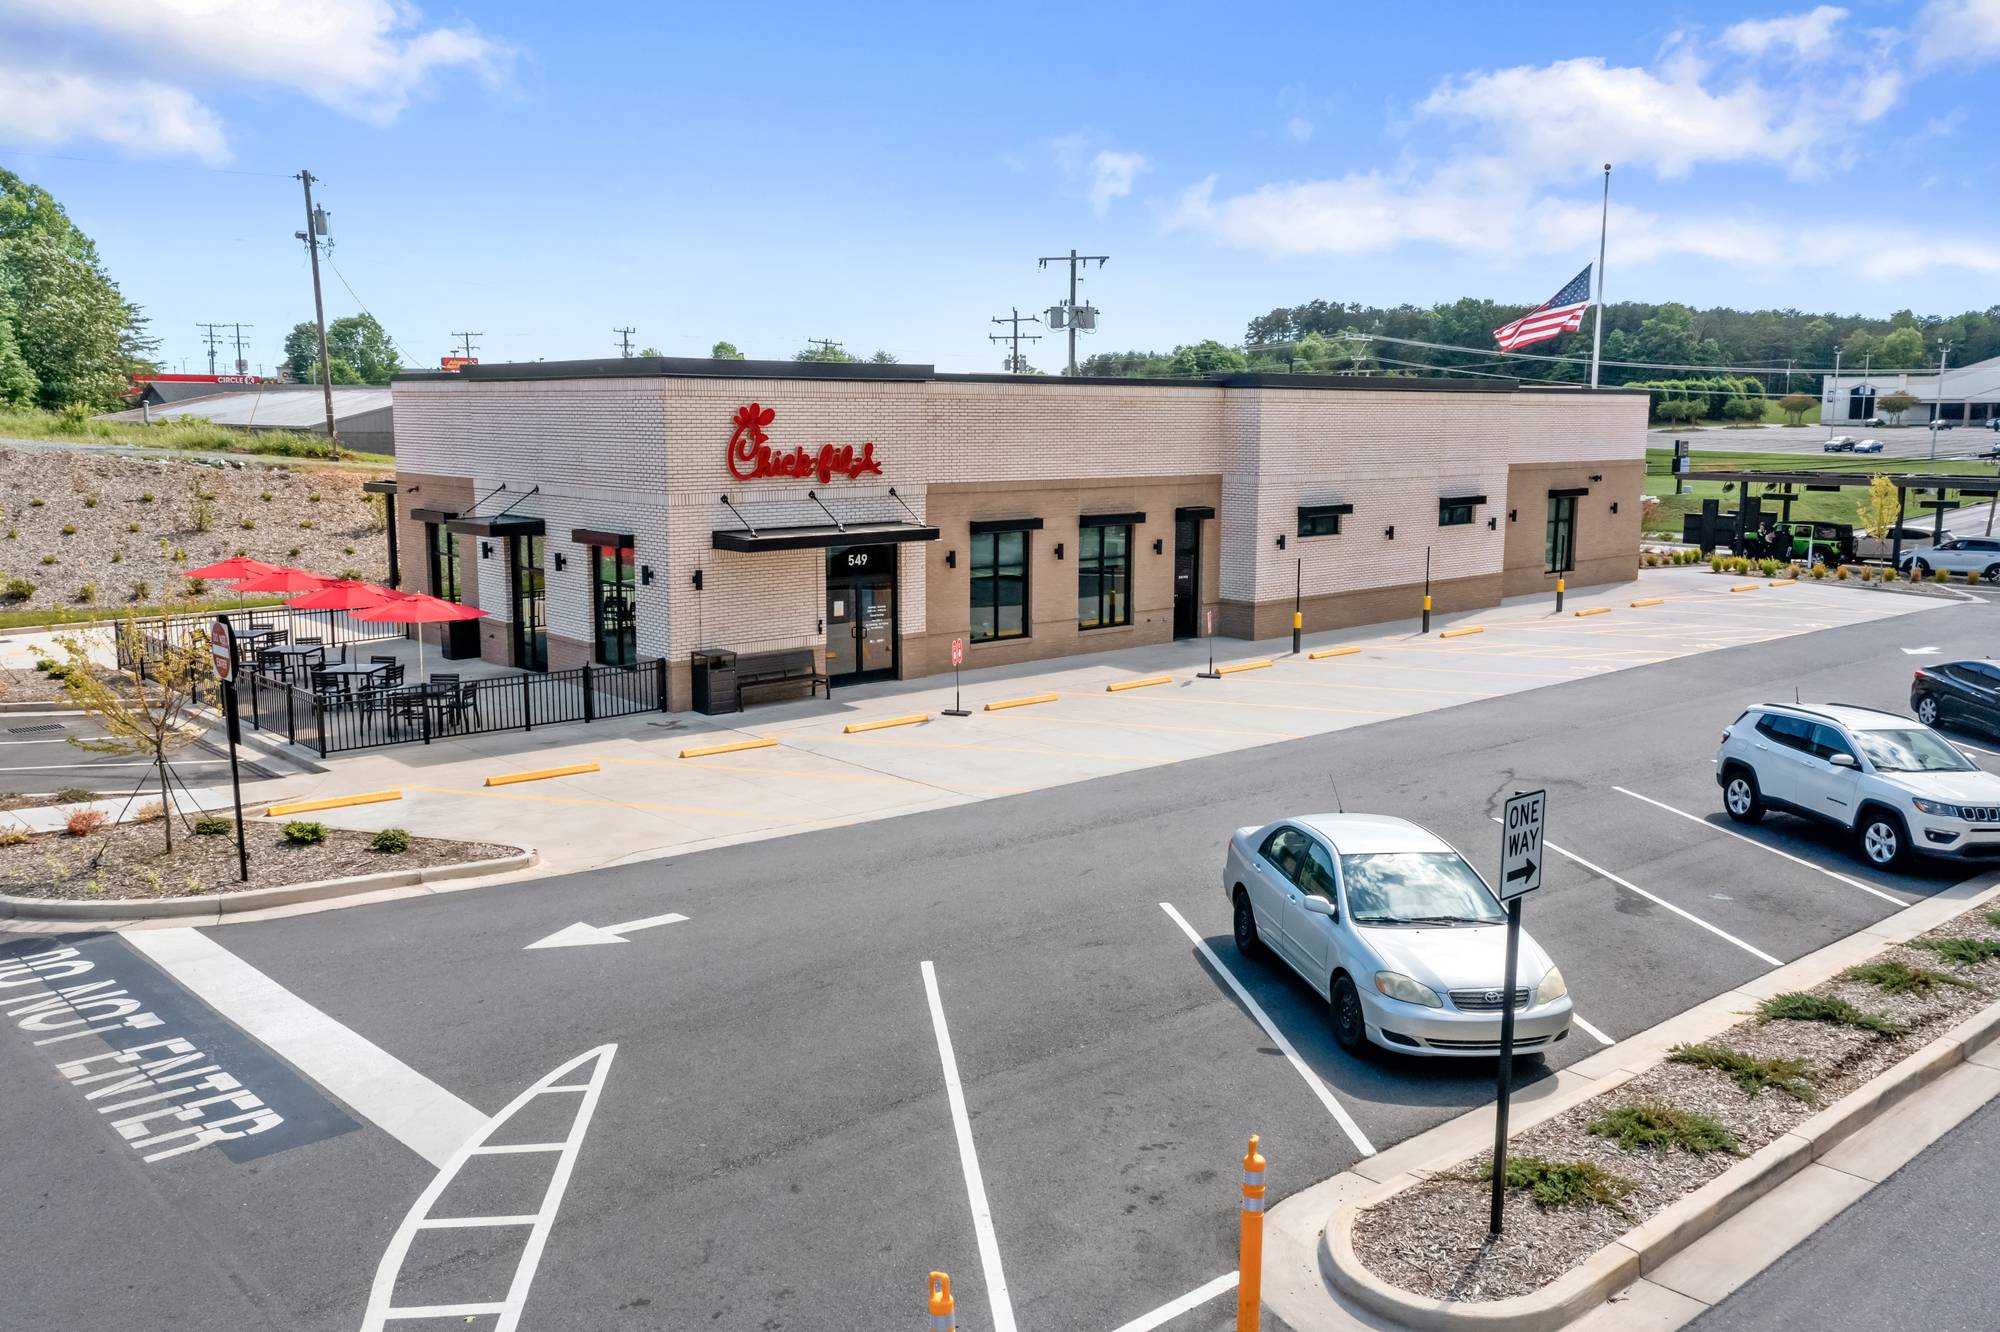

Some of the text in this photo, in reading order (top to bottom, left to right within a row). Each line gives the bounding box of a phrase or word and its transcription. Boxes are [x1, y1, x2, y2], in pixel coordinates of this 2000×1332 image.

[245, 376, 255, 384] K
[728, 403, 882, 484] Chick-fil-A
[848, 554, 868, 566] 549
[1510, 800, 1540, 829] ONE
[1509, 827, 1540, 858] WAY
[0, 979, 166, 1046] NOT
[55, 1037, 285, 1163] ENTER
